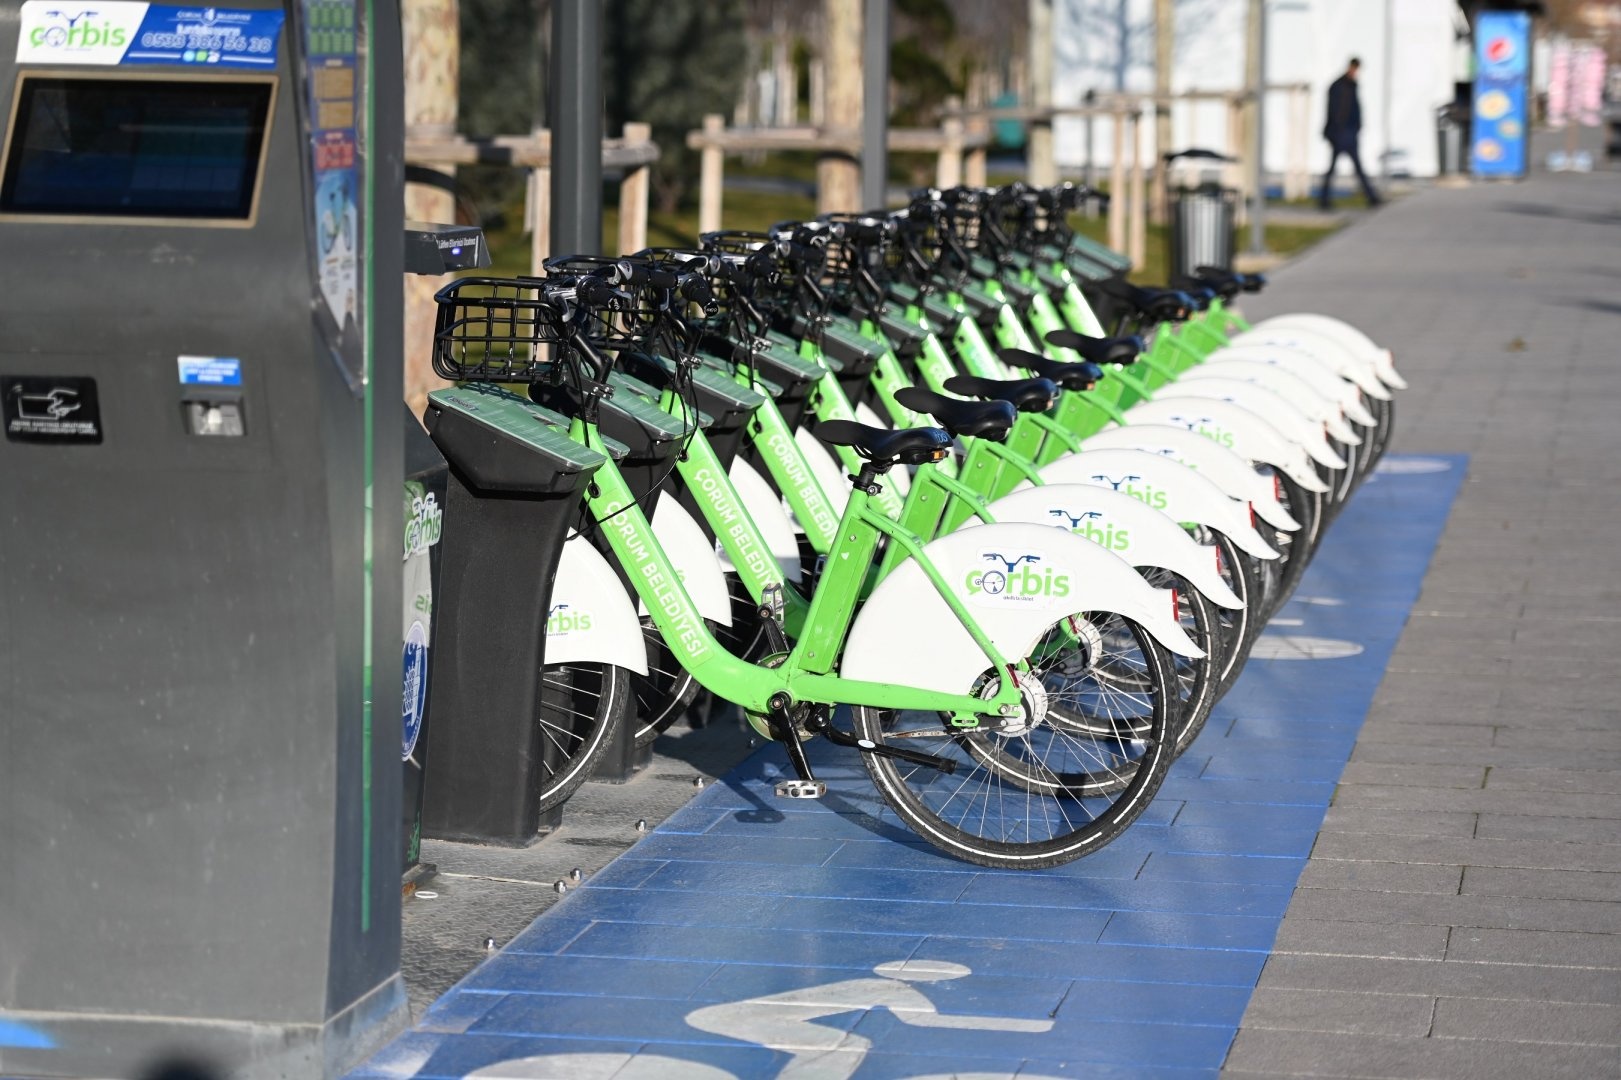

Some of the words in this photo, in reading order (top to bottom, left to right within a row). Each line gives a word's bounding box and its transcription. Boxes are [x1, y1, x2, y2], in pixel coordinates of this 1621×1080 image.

[693, 468, 738, 524] ÇORUM
[729, 523, 777, 586] BELEDİY
[768, 433, 808, 487] ÇORUM
[800, 486, 836, 544] BELEDİ
[548, 611, 592, 633] rbis
[604, 501, 650, 563] ÇORUM
[641, 561, 708, 658] BELEDİYESİ
